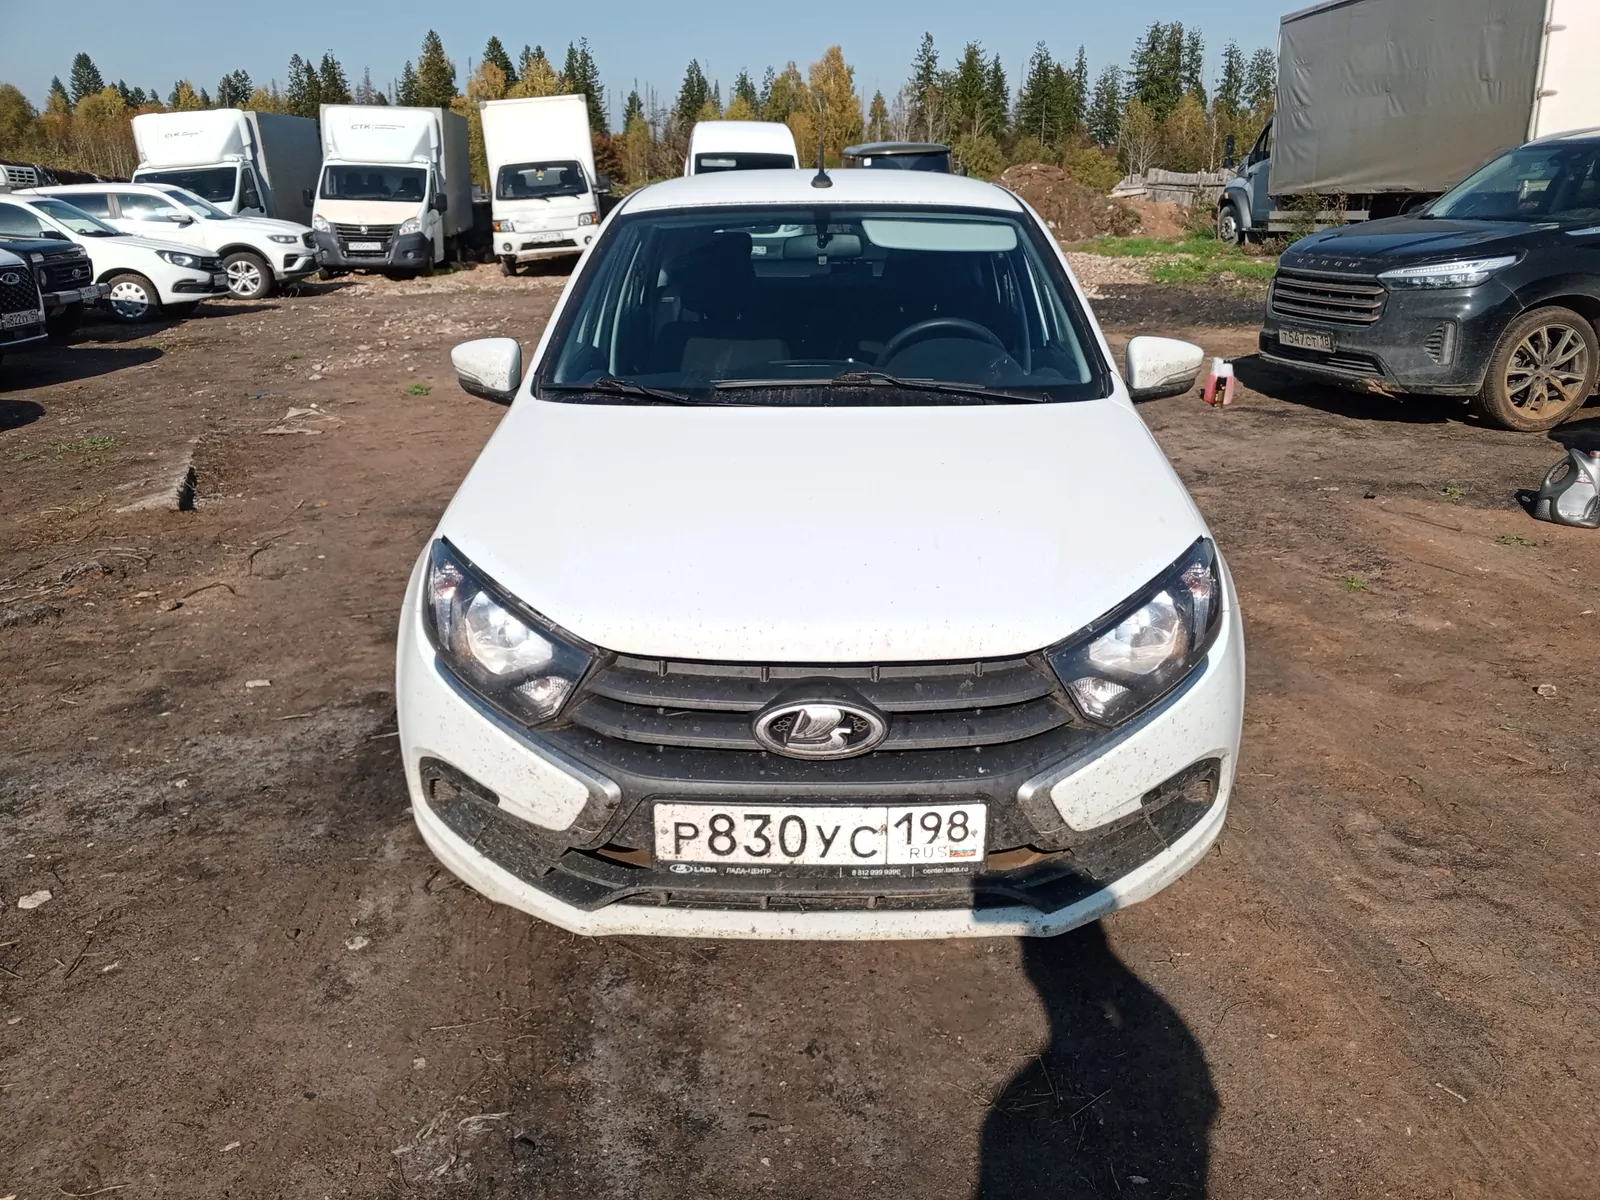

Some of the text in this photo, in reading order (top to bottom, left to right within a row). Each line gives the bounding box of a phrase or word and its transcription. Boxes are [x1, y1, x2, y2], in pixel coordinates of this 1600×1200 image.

[673, 810, 969, 858] Р830УС 198
[909, 846, 947, 859] RUS
